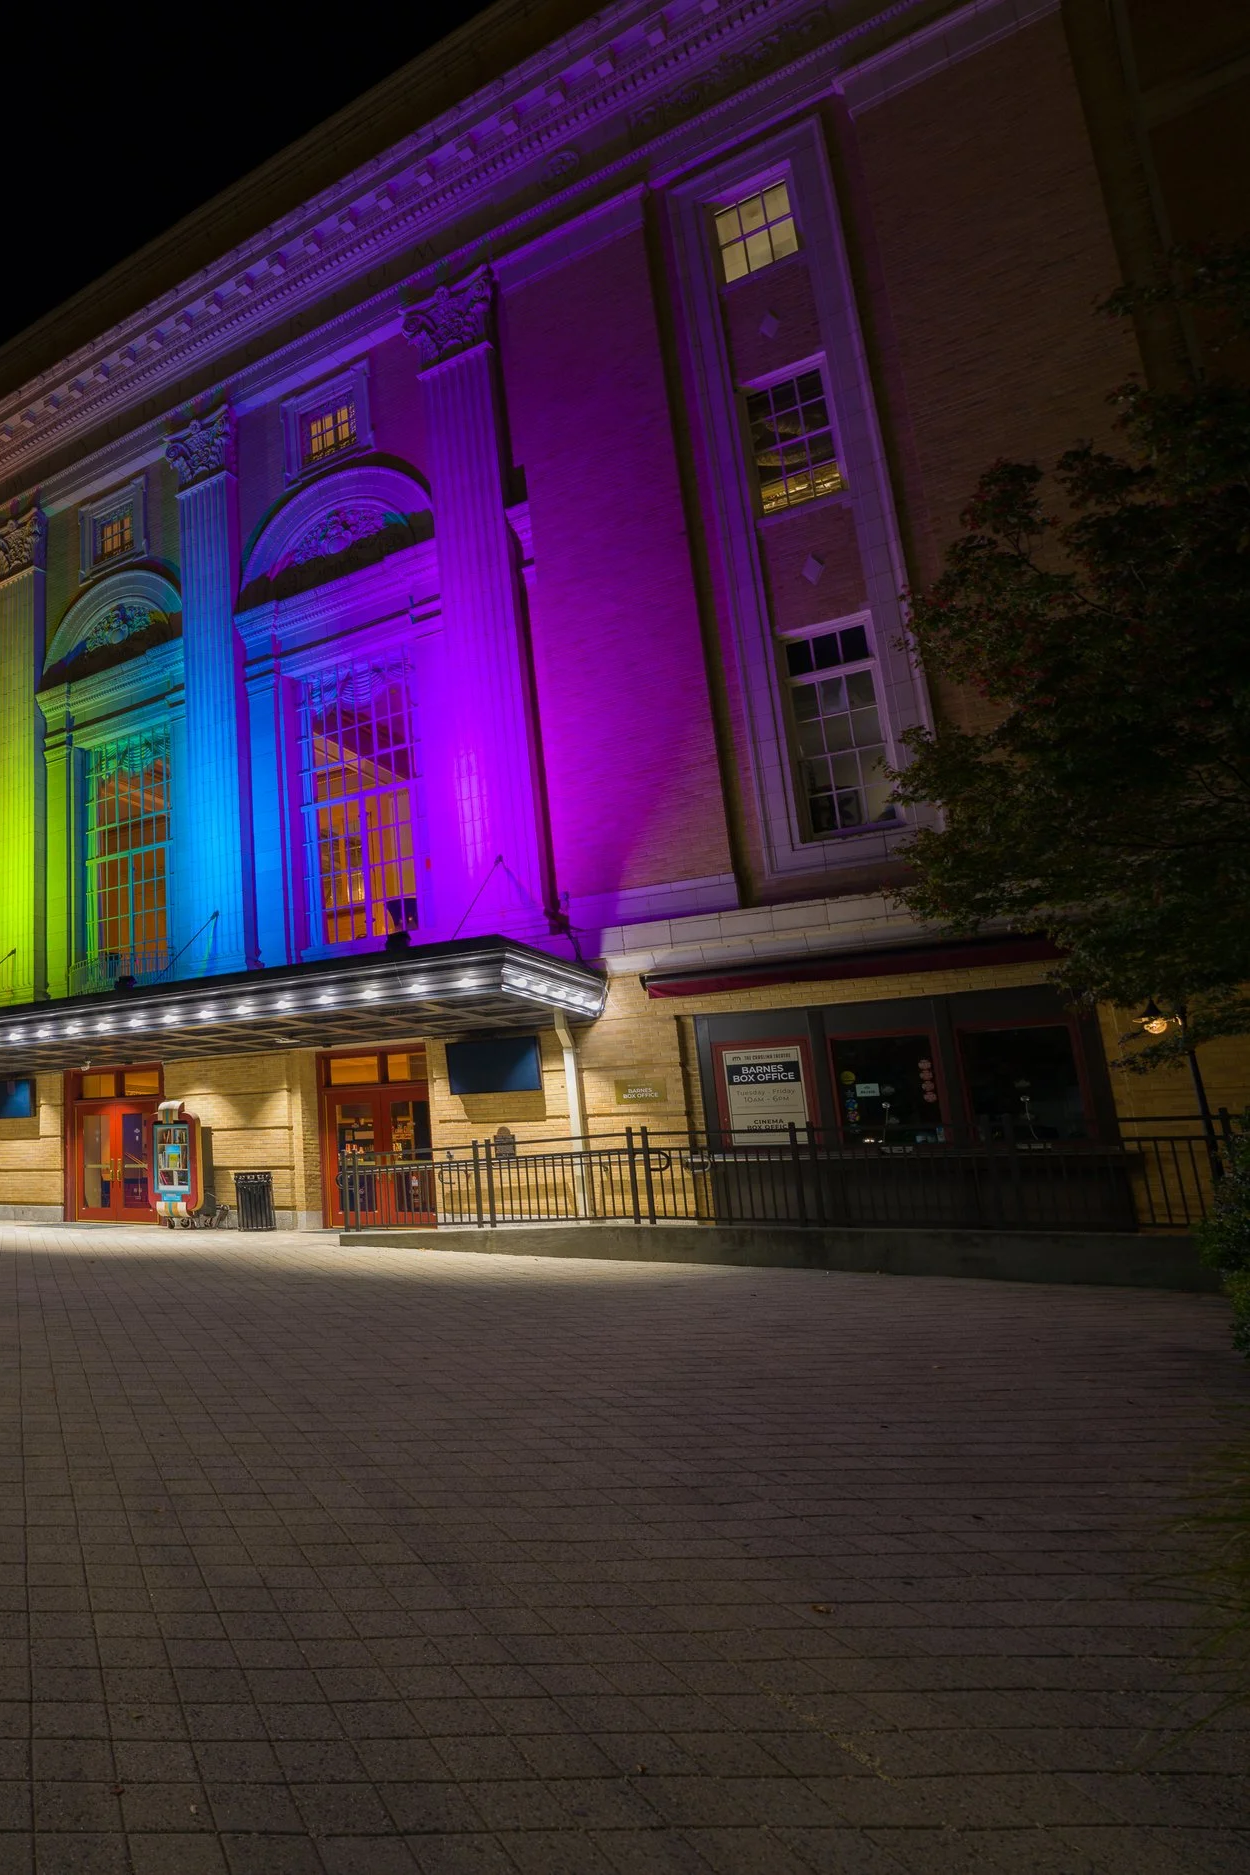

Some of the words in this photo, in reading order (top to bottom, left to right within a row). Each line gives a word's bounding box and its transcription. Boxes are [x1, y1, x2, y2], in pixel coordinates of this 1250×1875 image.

[741, 1065, 784, 1074] BARNES
[733, 1074, 755, 1083] BOX
[757, 1072, 796, 1081] OFFICE
[772, 1088, 796, 1096] Friday
